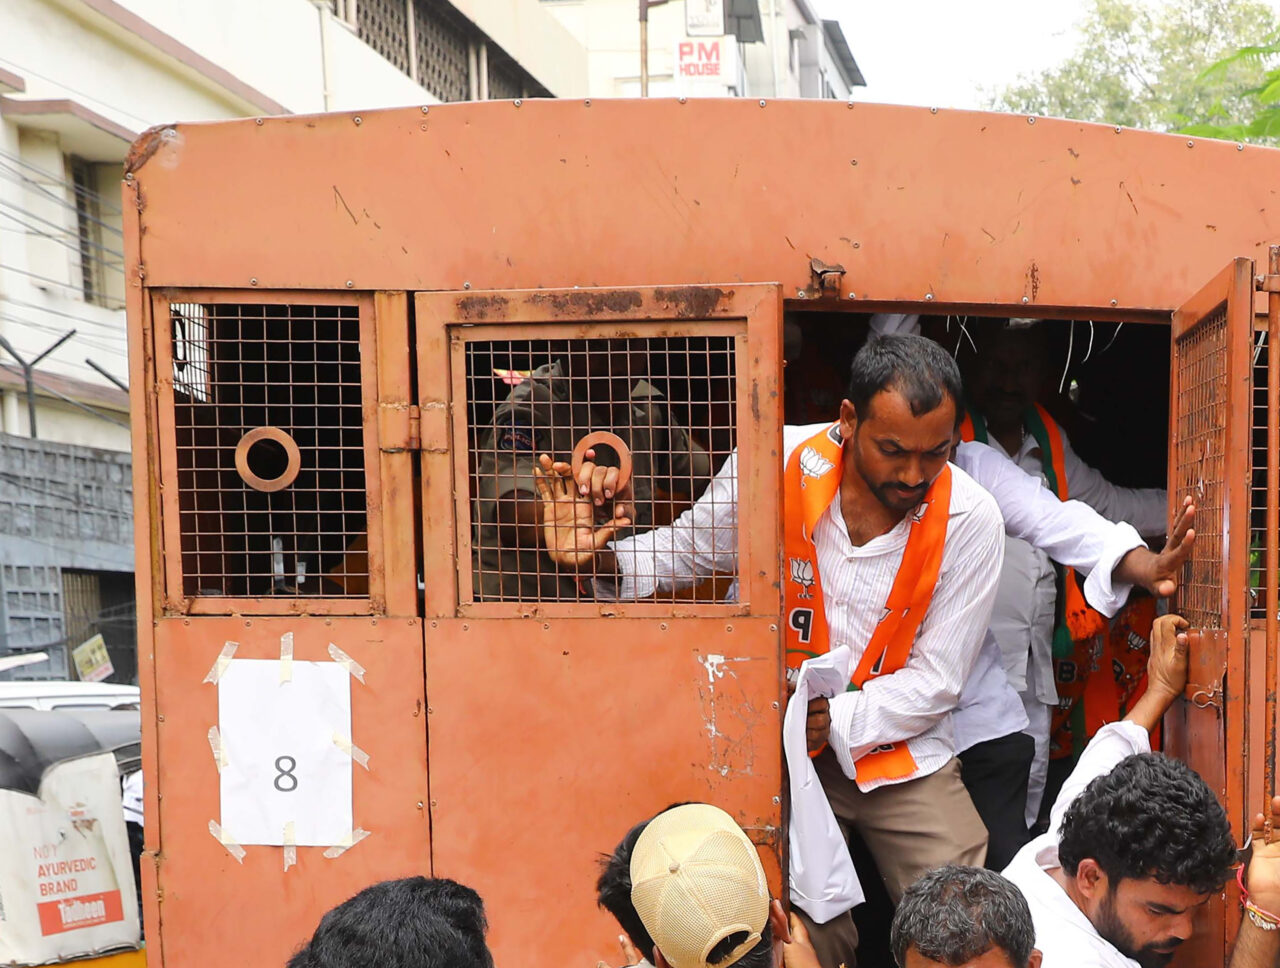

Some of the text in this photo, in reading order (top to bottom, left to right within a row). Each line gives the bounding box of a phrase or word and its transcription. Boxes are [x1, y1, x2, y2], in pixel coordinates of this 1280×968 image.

[679, 63, 721, 77] HOUSE
[273, 755, 298, 792] 8
[38, 857, 96, 878] AYURVEDIC
[39, 879, 78, 897] BRAND
